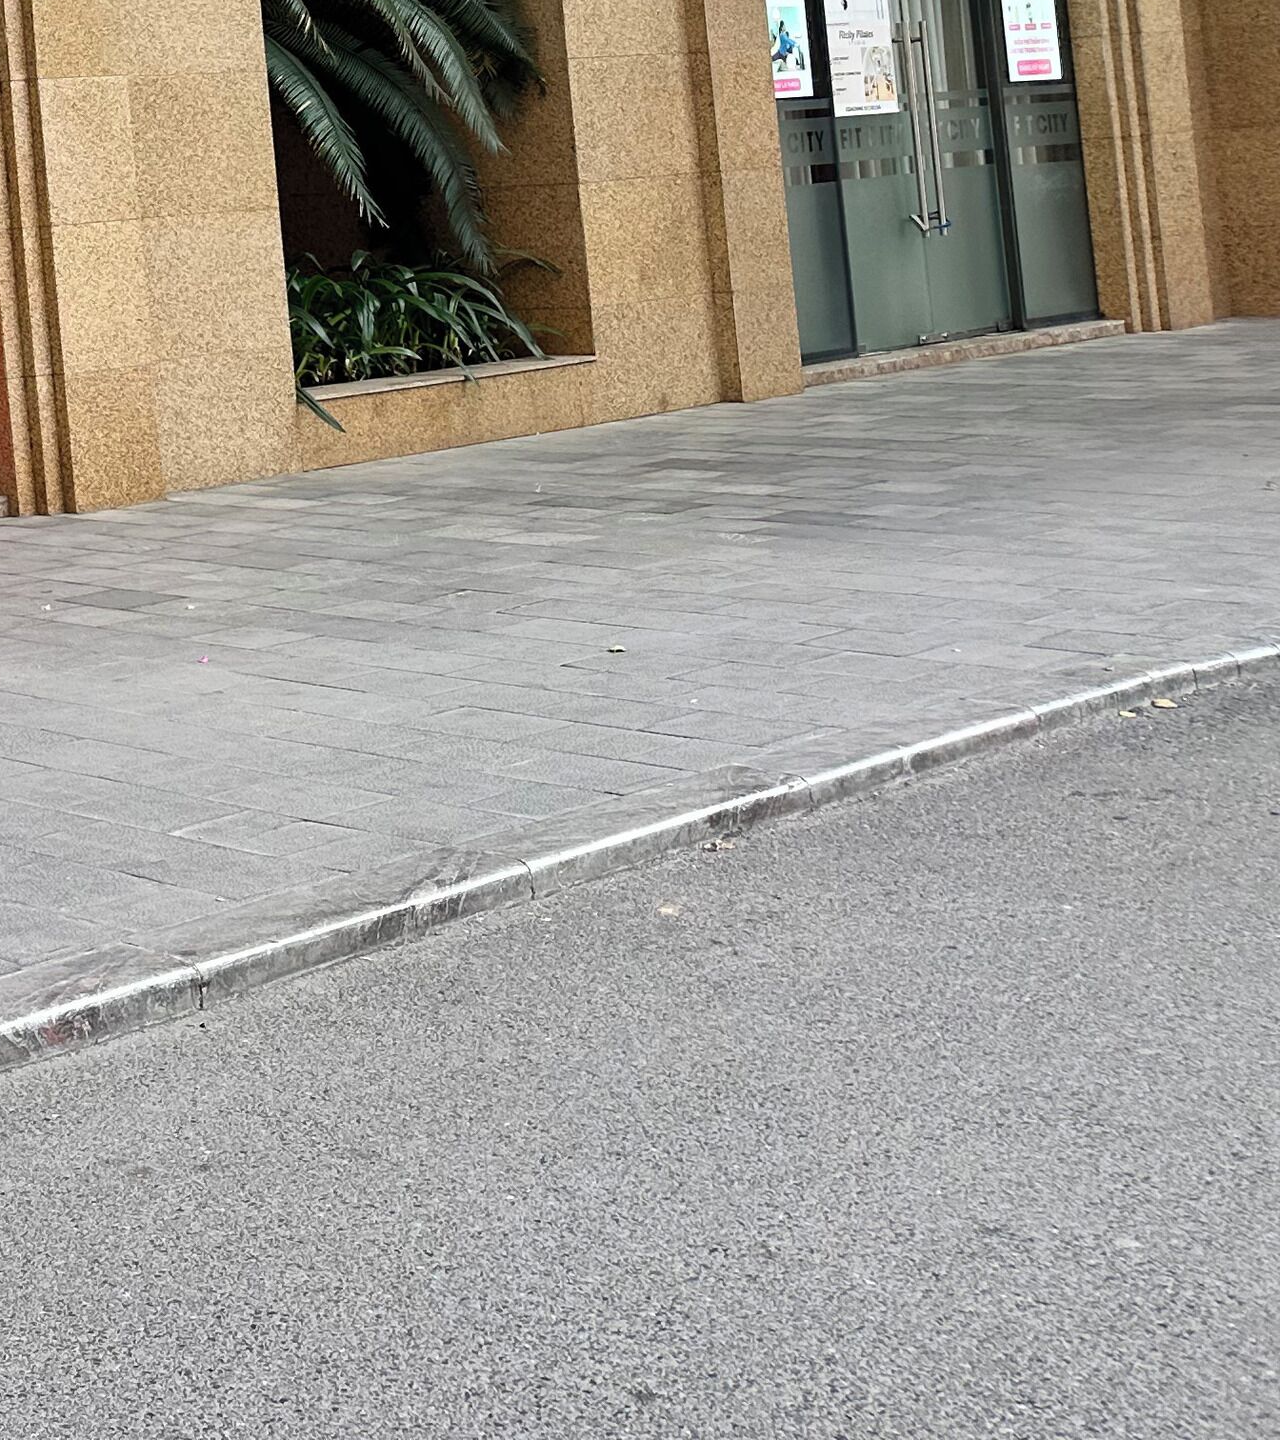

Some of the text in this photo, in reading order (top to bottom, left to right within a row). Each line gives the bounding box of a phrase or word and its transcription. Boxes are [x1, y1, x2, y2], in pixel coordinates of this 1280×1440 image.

[1014, 113, 1069, 137] FT CITY
[787, 130, 825, 154] CITY
